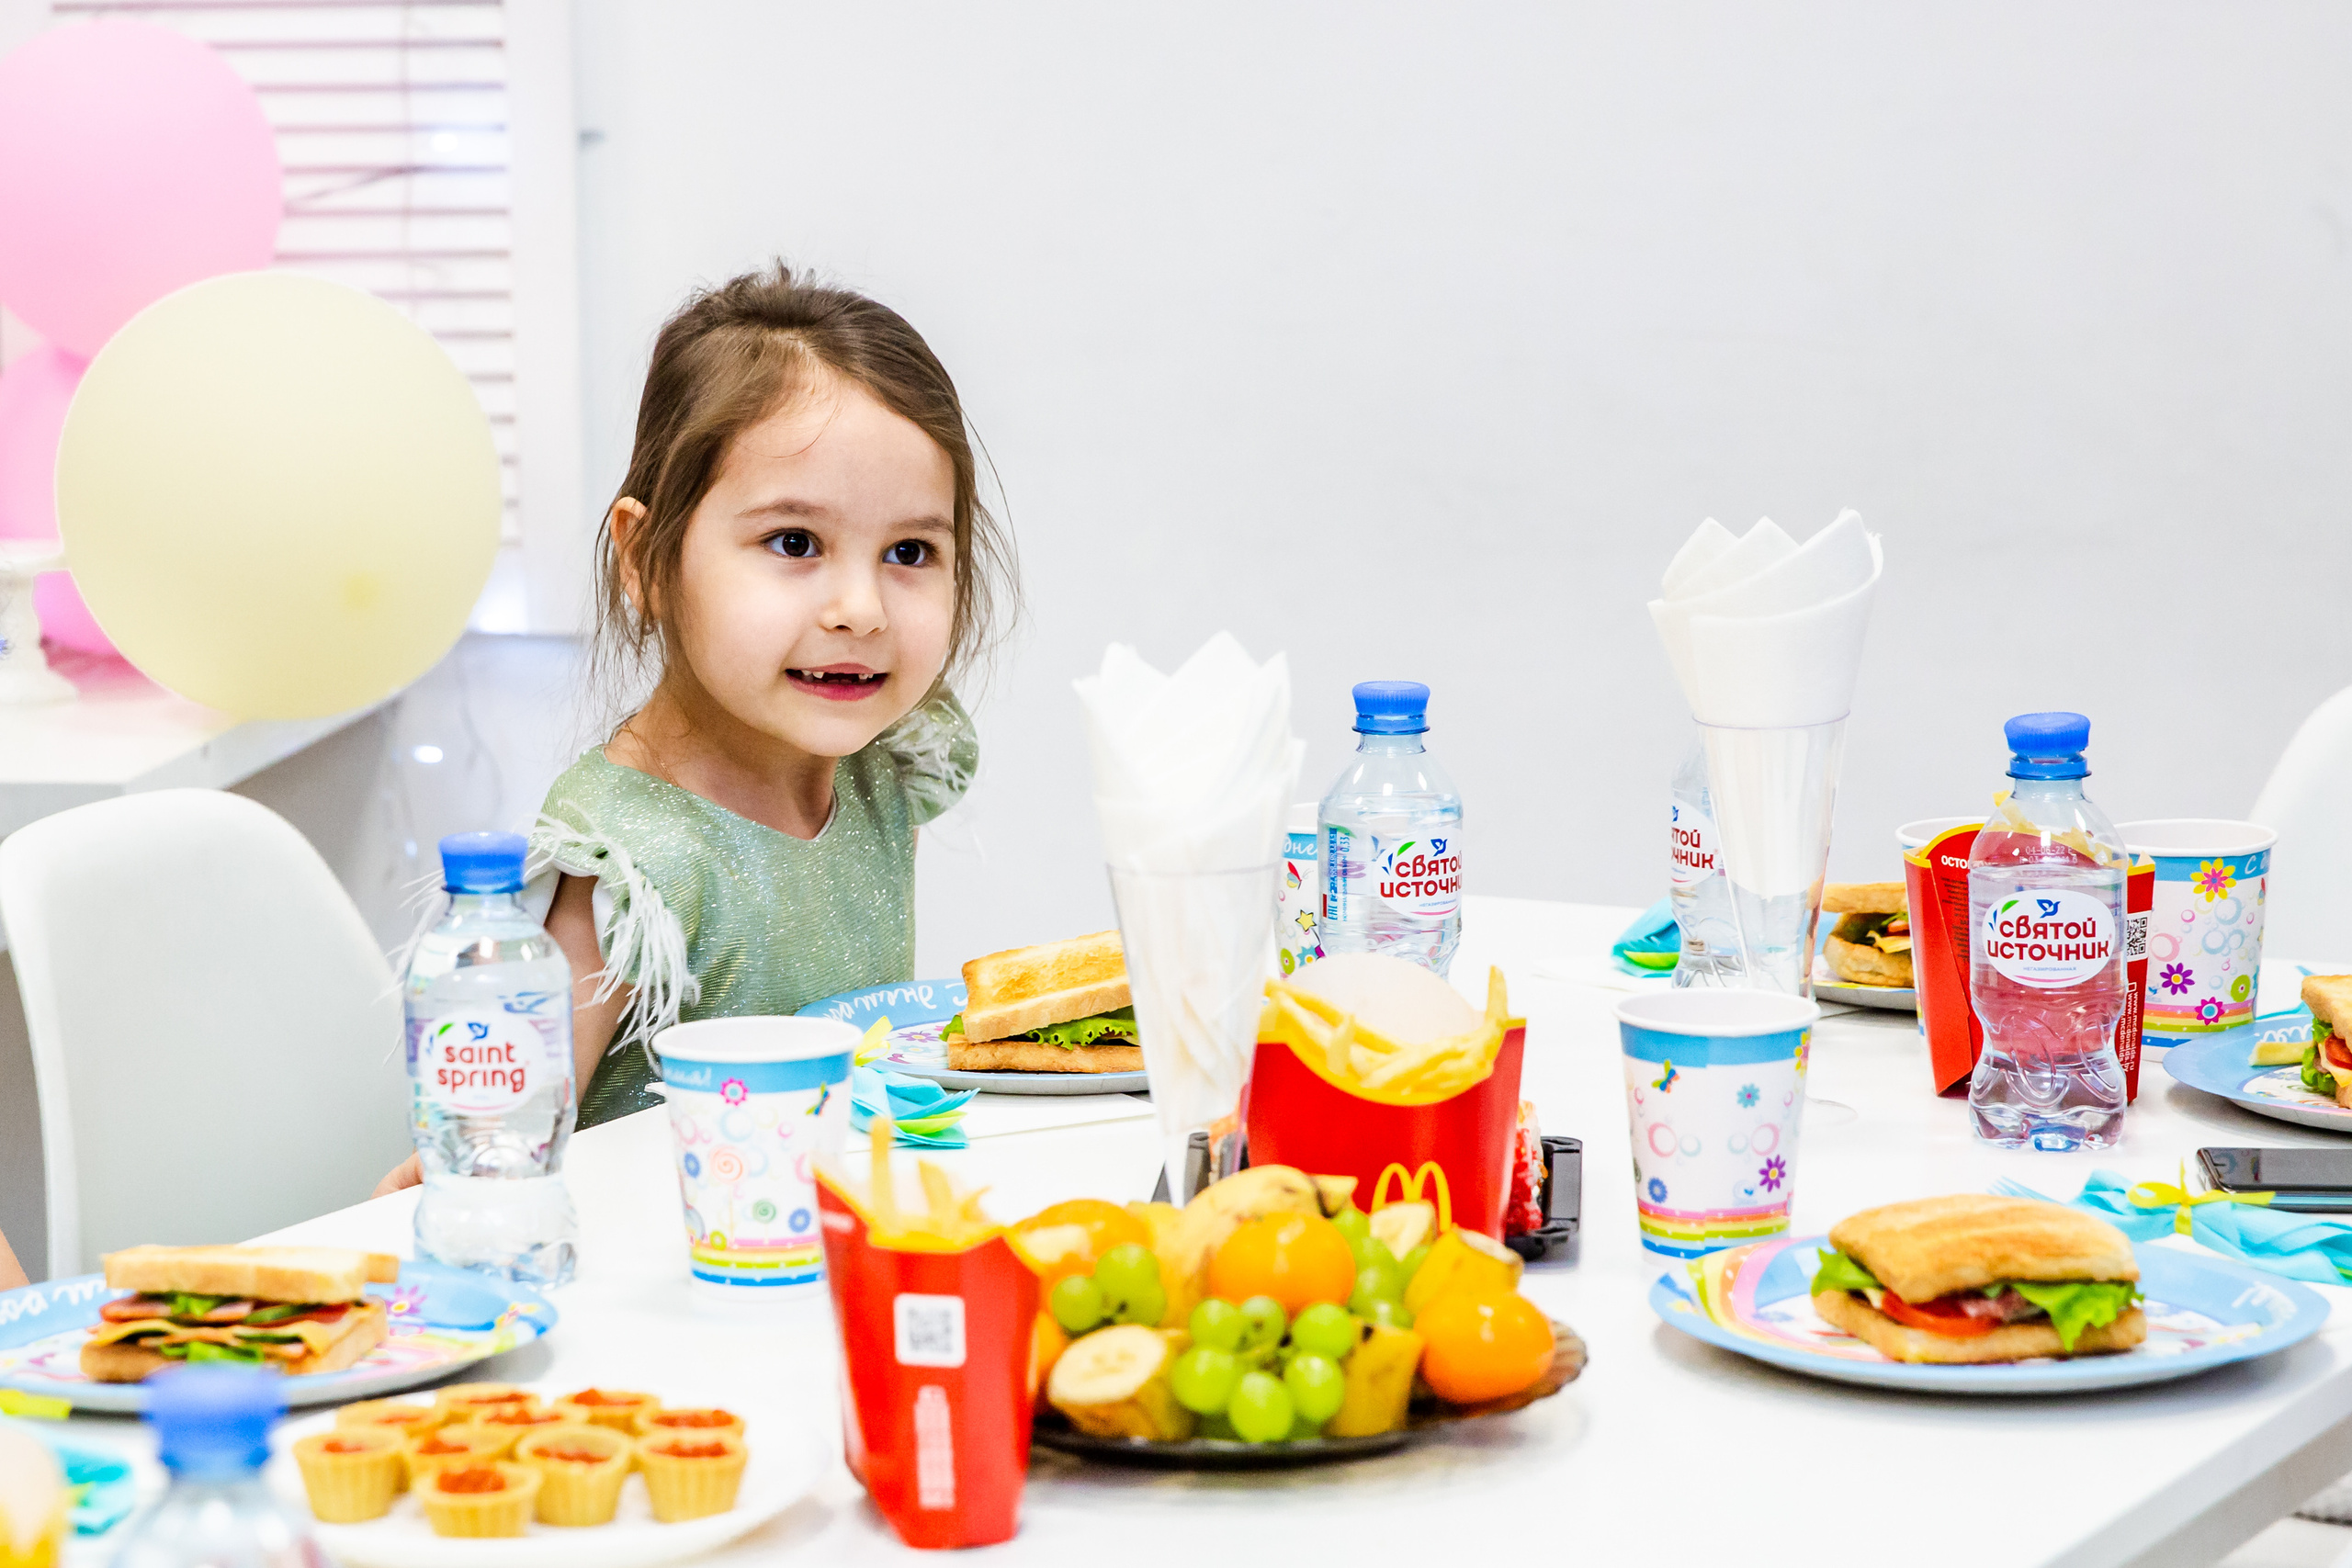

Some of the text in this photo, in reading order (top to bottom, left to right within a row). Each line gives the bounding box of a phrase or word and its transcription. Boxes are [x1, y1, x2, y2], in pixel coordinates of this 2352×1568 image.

[1941, 854, 1969, 869] ОСТО
[2123, 993, 2133, 1073] www.mcdonalds.by
[2129, 991, 2139, 1071] www.mcdonalds.ru
[446, 1042, 516, 1064] saint
[437, 1068, 525, 1093] spring
